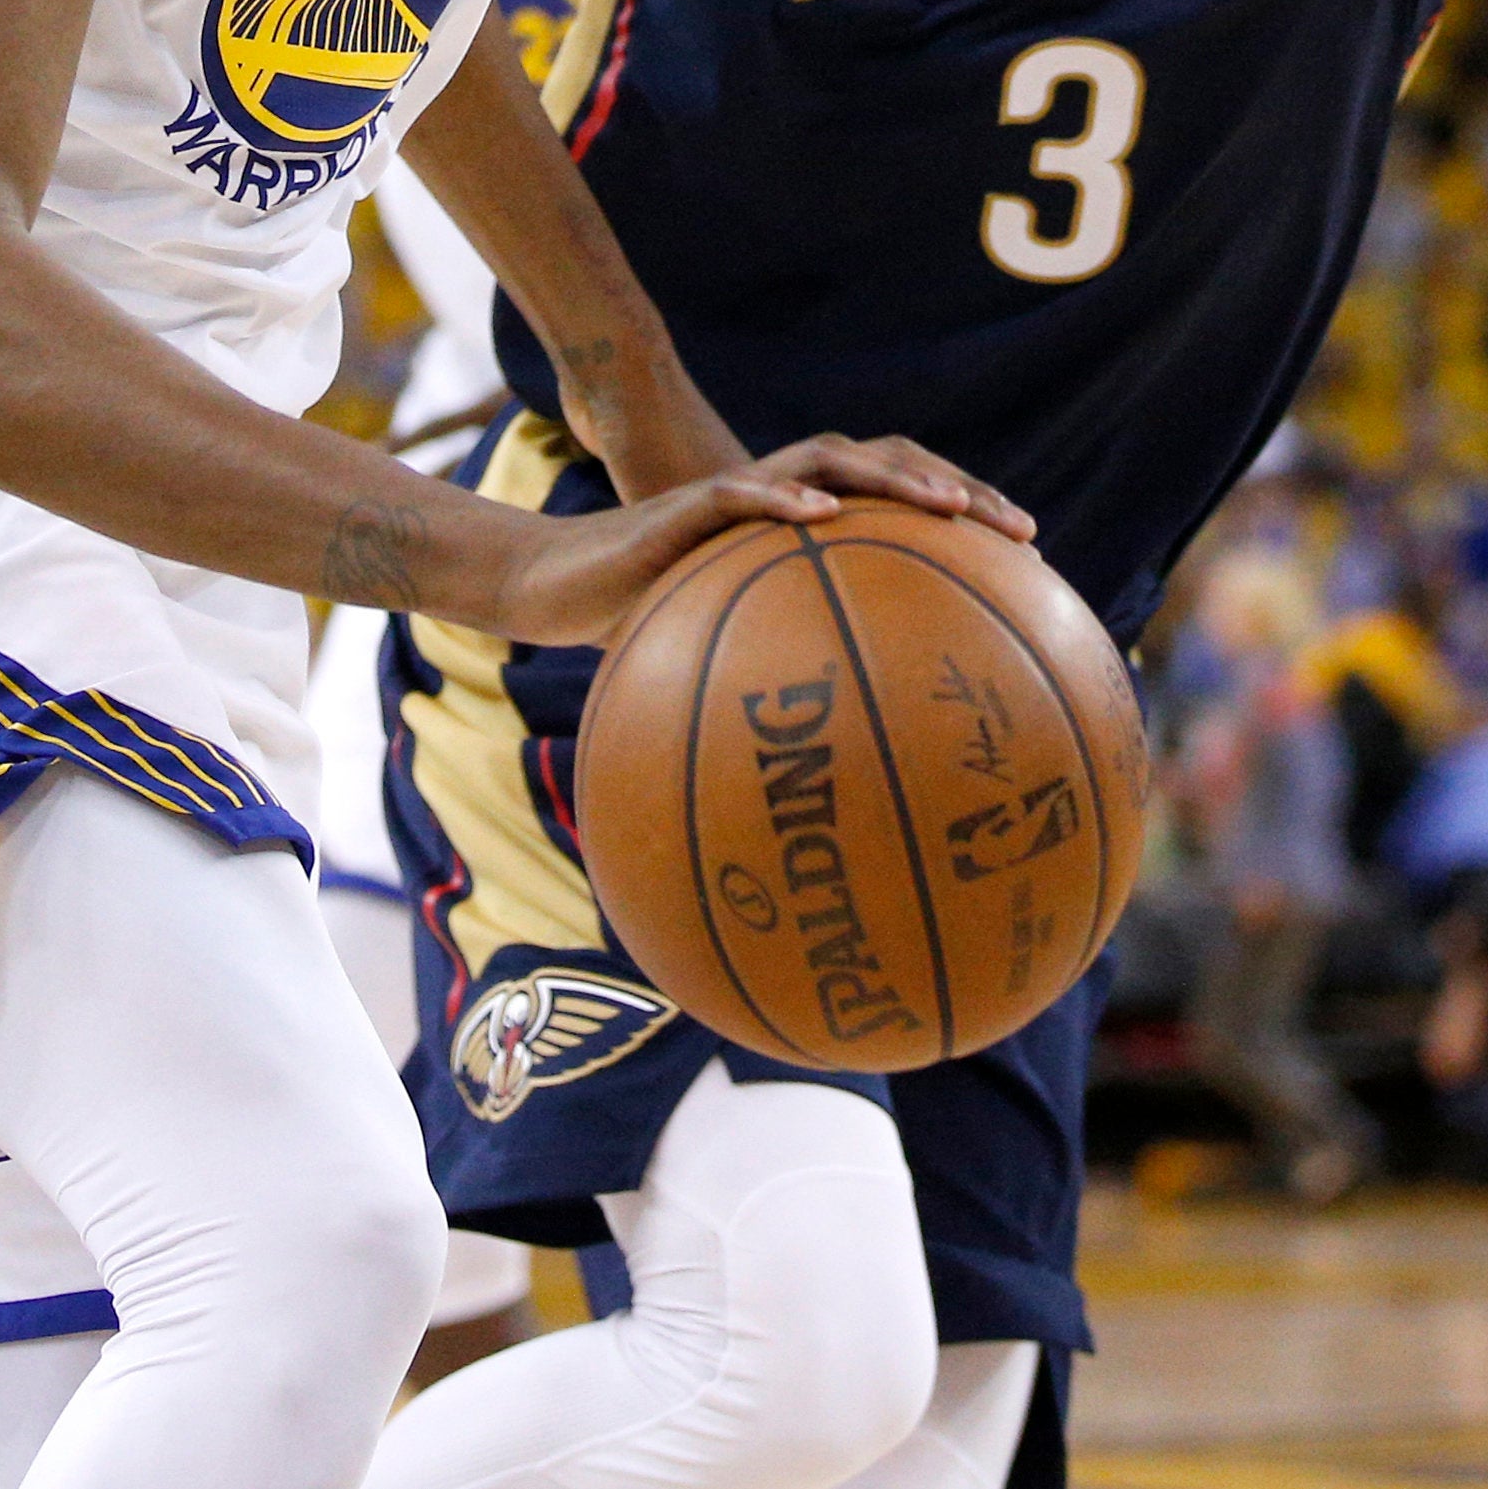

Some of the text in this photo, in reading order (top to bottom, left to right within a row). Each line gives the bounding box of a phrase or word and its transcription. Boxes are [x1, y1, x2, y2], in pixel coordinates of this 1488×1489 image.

[163, 60, 416, 211] WARRIO
[978, 36, 1147, 286] 3
[741, 678, 924, 1043] SPALDING
